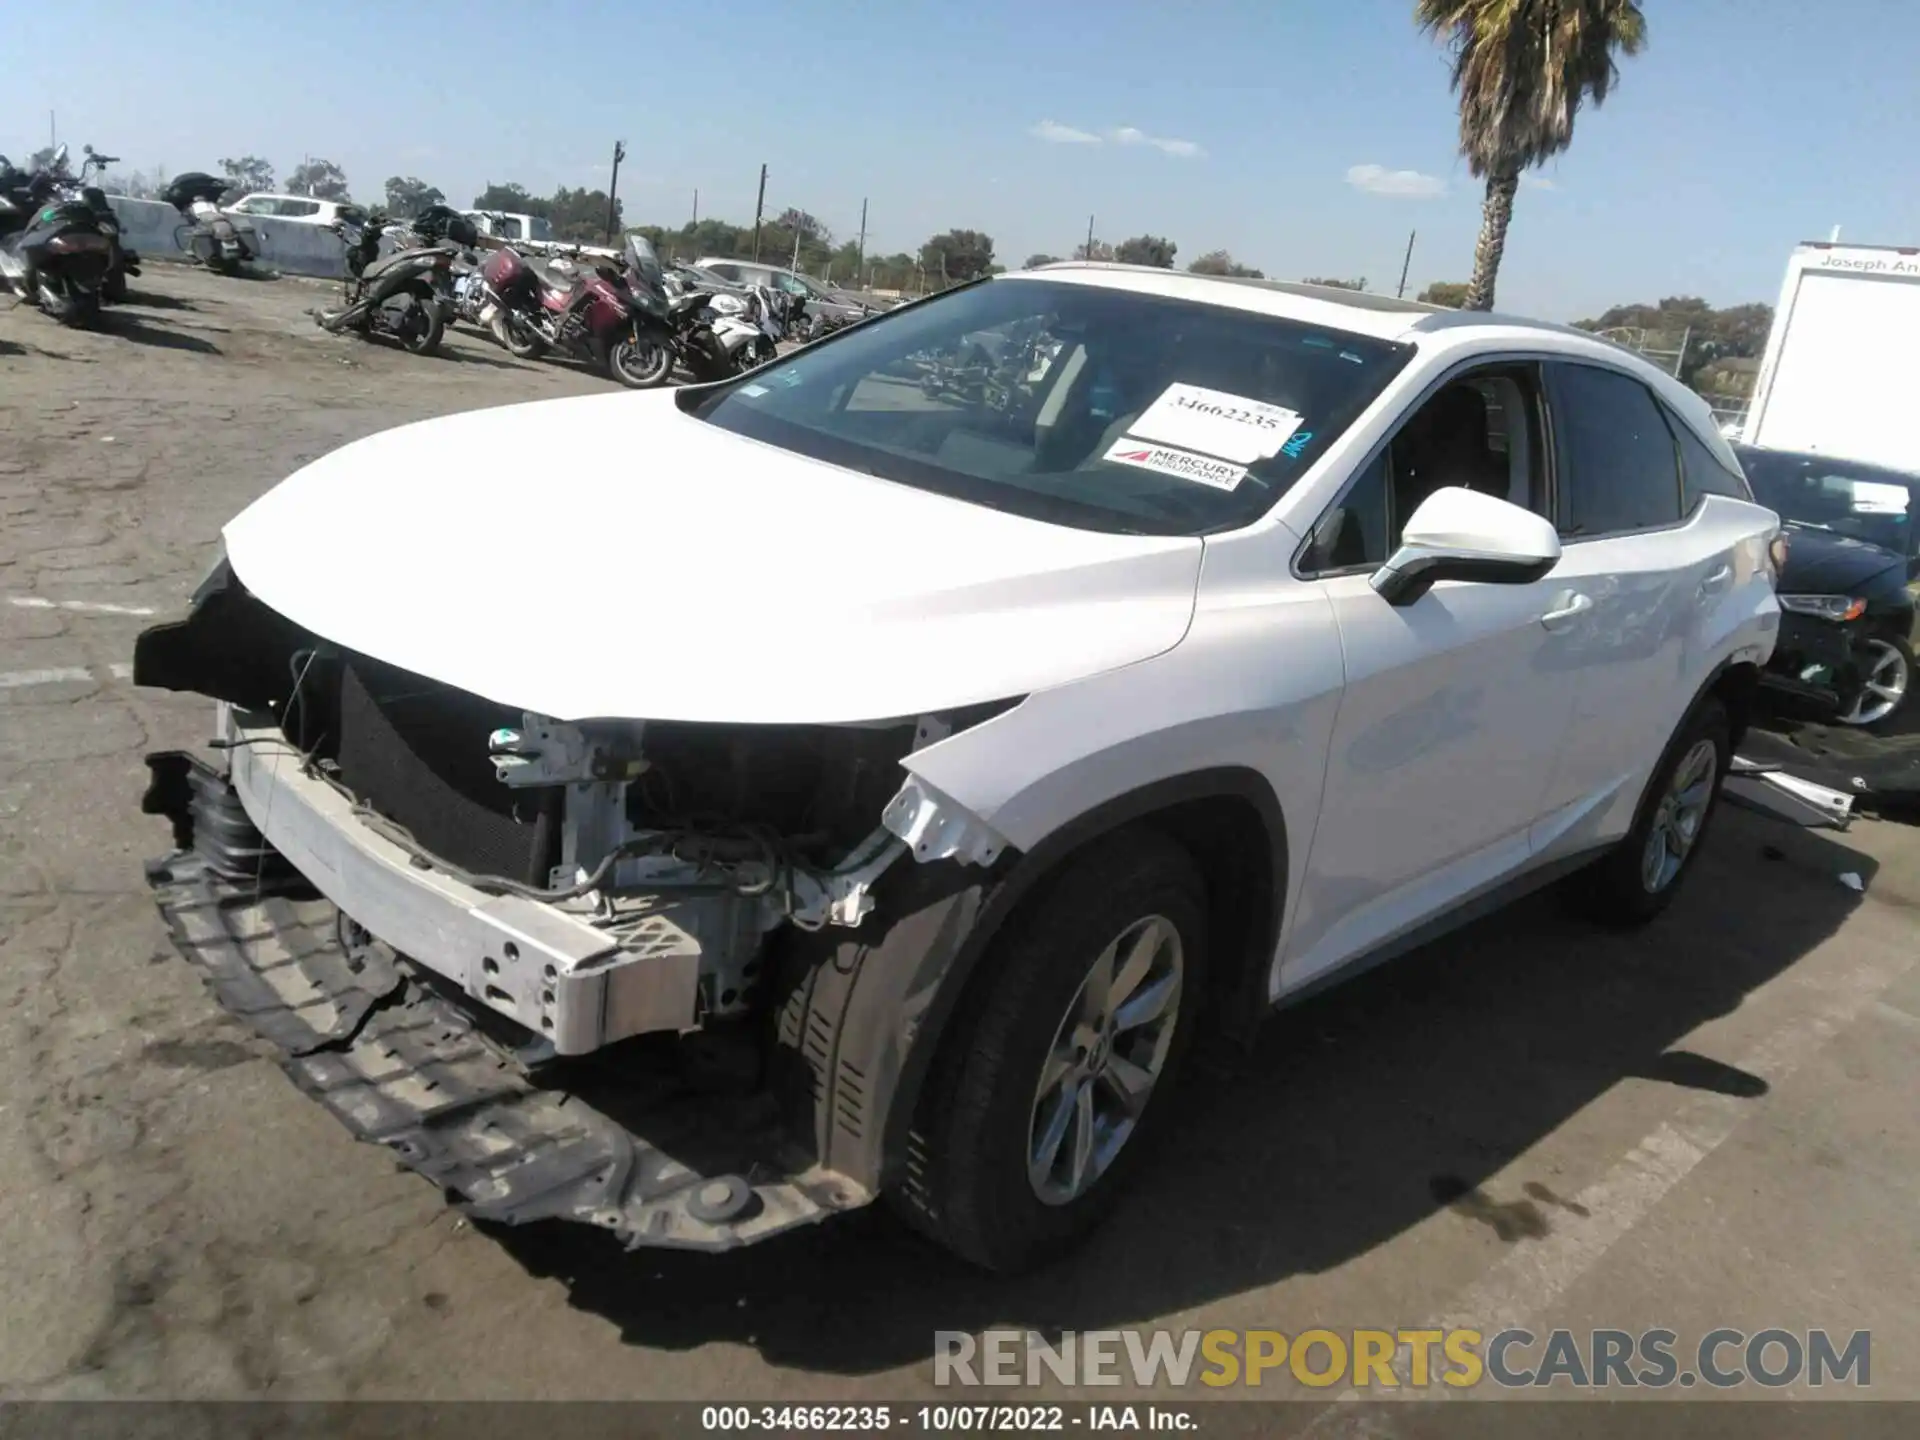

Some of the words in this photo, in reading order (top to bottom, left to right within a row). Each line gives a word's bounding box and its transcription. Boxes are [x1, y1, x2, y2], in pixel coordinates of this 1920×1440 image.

[1821, 255, 1886, 271] Joseph
[1169, 396, 1280, 429] 34662235
[1149, 457, 1236, 485] INSURANCE
[1155, 450, 1240, 477] MERCURY
